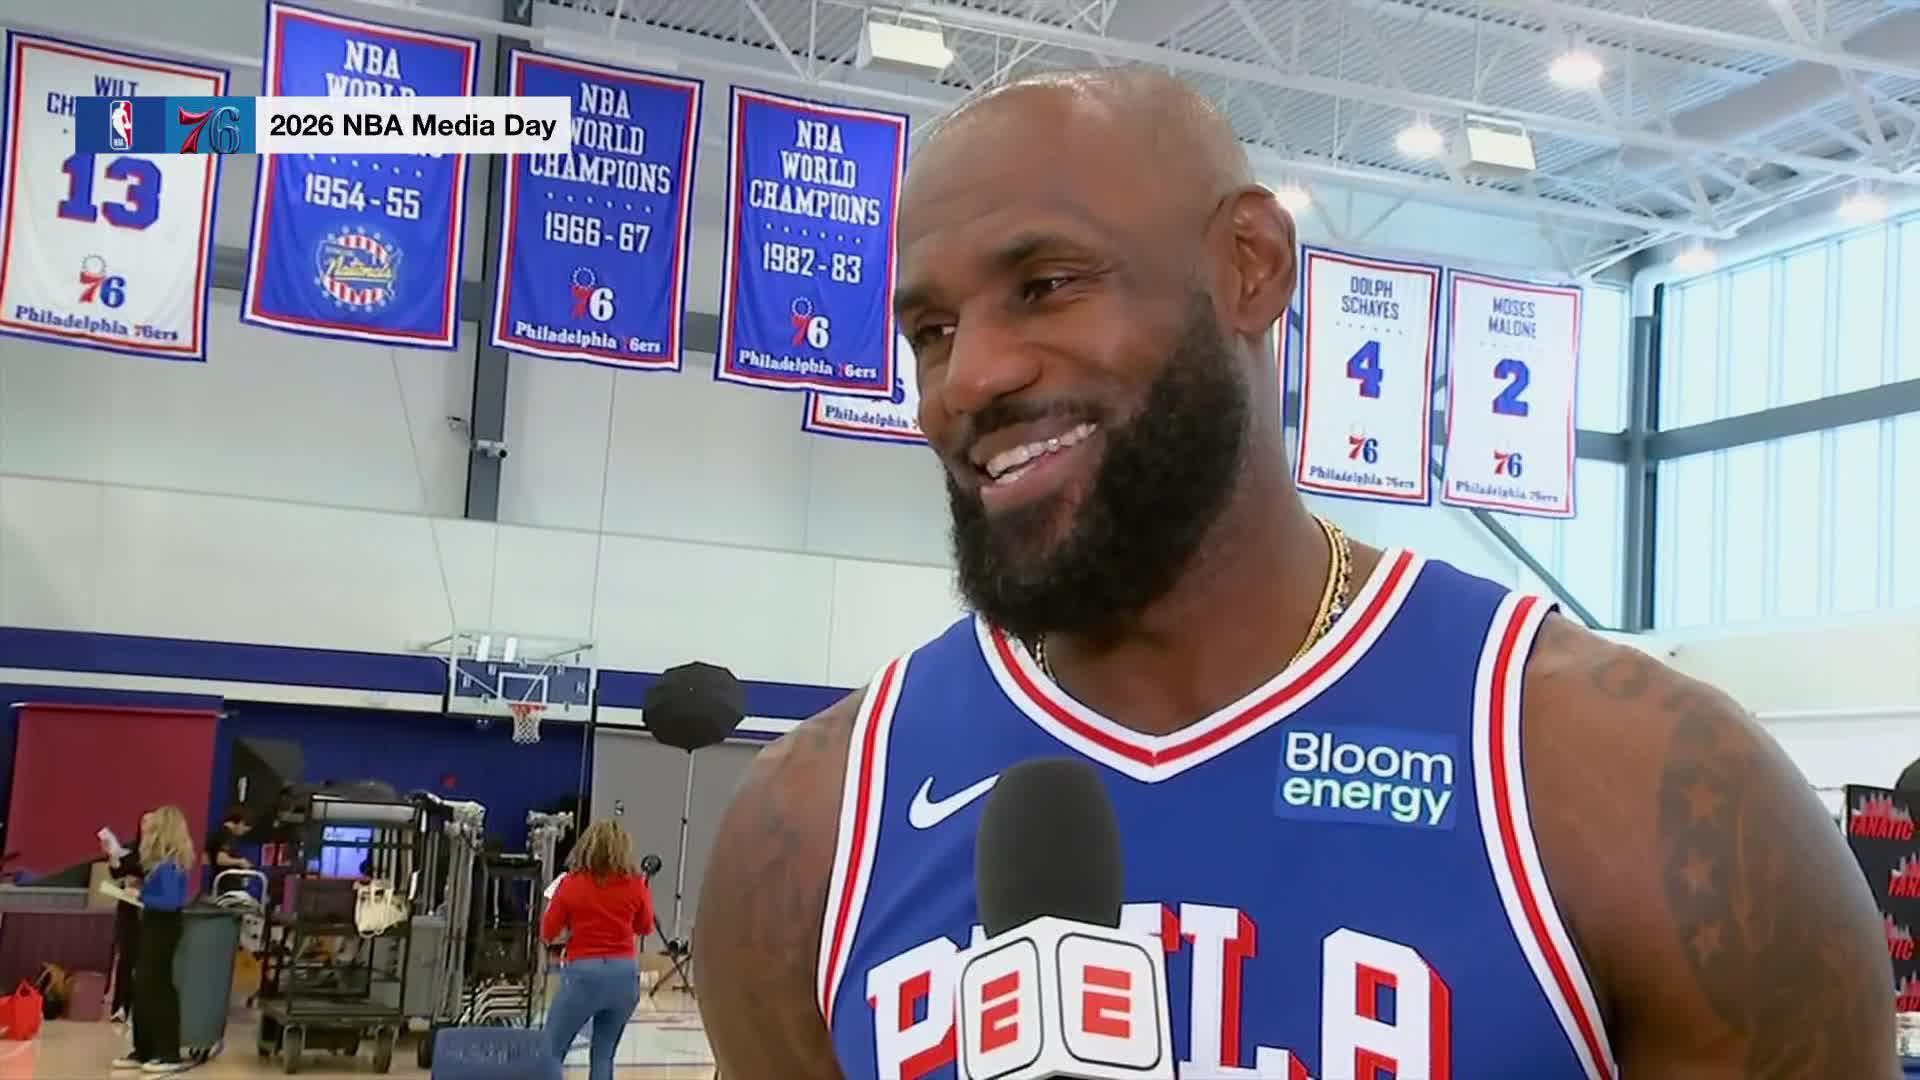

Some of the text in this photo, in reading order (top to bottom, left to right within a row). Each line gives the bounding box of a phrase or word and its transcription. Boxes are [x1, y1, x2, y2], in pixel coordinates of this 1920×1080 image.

[344, 39, 400, 79] NBA
[580, 82, 630, 119] NBA
[796, 120, 844, 154] NBA
[530, 152, 672, 194] CHAMPIONS
[781, 150, 857, 188] WORLD
[57, 152, 163, 231] 13
[750, 179, 880, 226] CHAMPIONS
[79, 272, 126, 308] 76
[571, 285, 615, 321] 76
[1350, 276, 1393, 298] DOLPH
[15, 305, 179, 341] Philadelphia 76ers
[1341, 296, 1400, 320] SCHAYES
[1493, 296, 1536, 319] MOSES
[515, 321, 617, 349] Philadelphia
[791, 315, 829, 349] 76
[1488, 315, 1537, 339] MALONE
[739, 350, 833, 375] Philadelphia
[1346, 340, 1383, 399] 4
[1492, 358, 1530, 417] 2
[825, 405, 908, 428] Philadelphia
[1348, 434, 1378, 464] 76
[1493, 450, 1522, 478] 76
[1286, 732, 1453, 784] Bloom
[1282, 777, 1452, 825] energy
[866, 902, 1452, 1080] PLA
